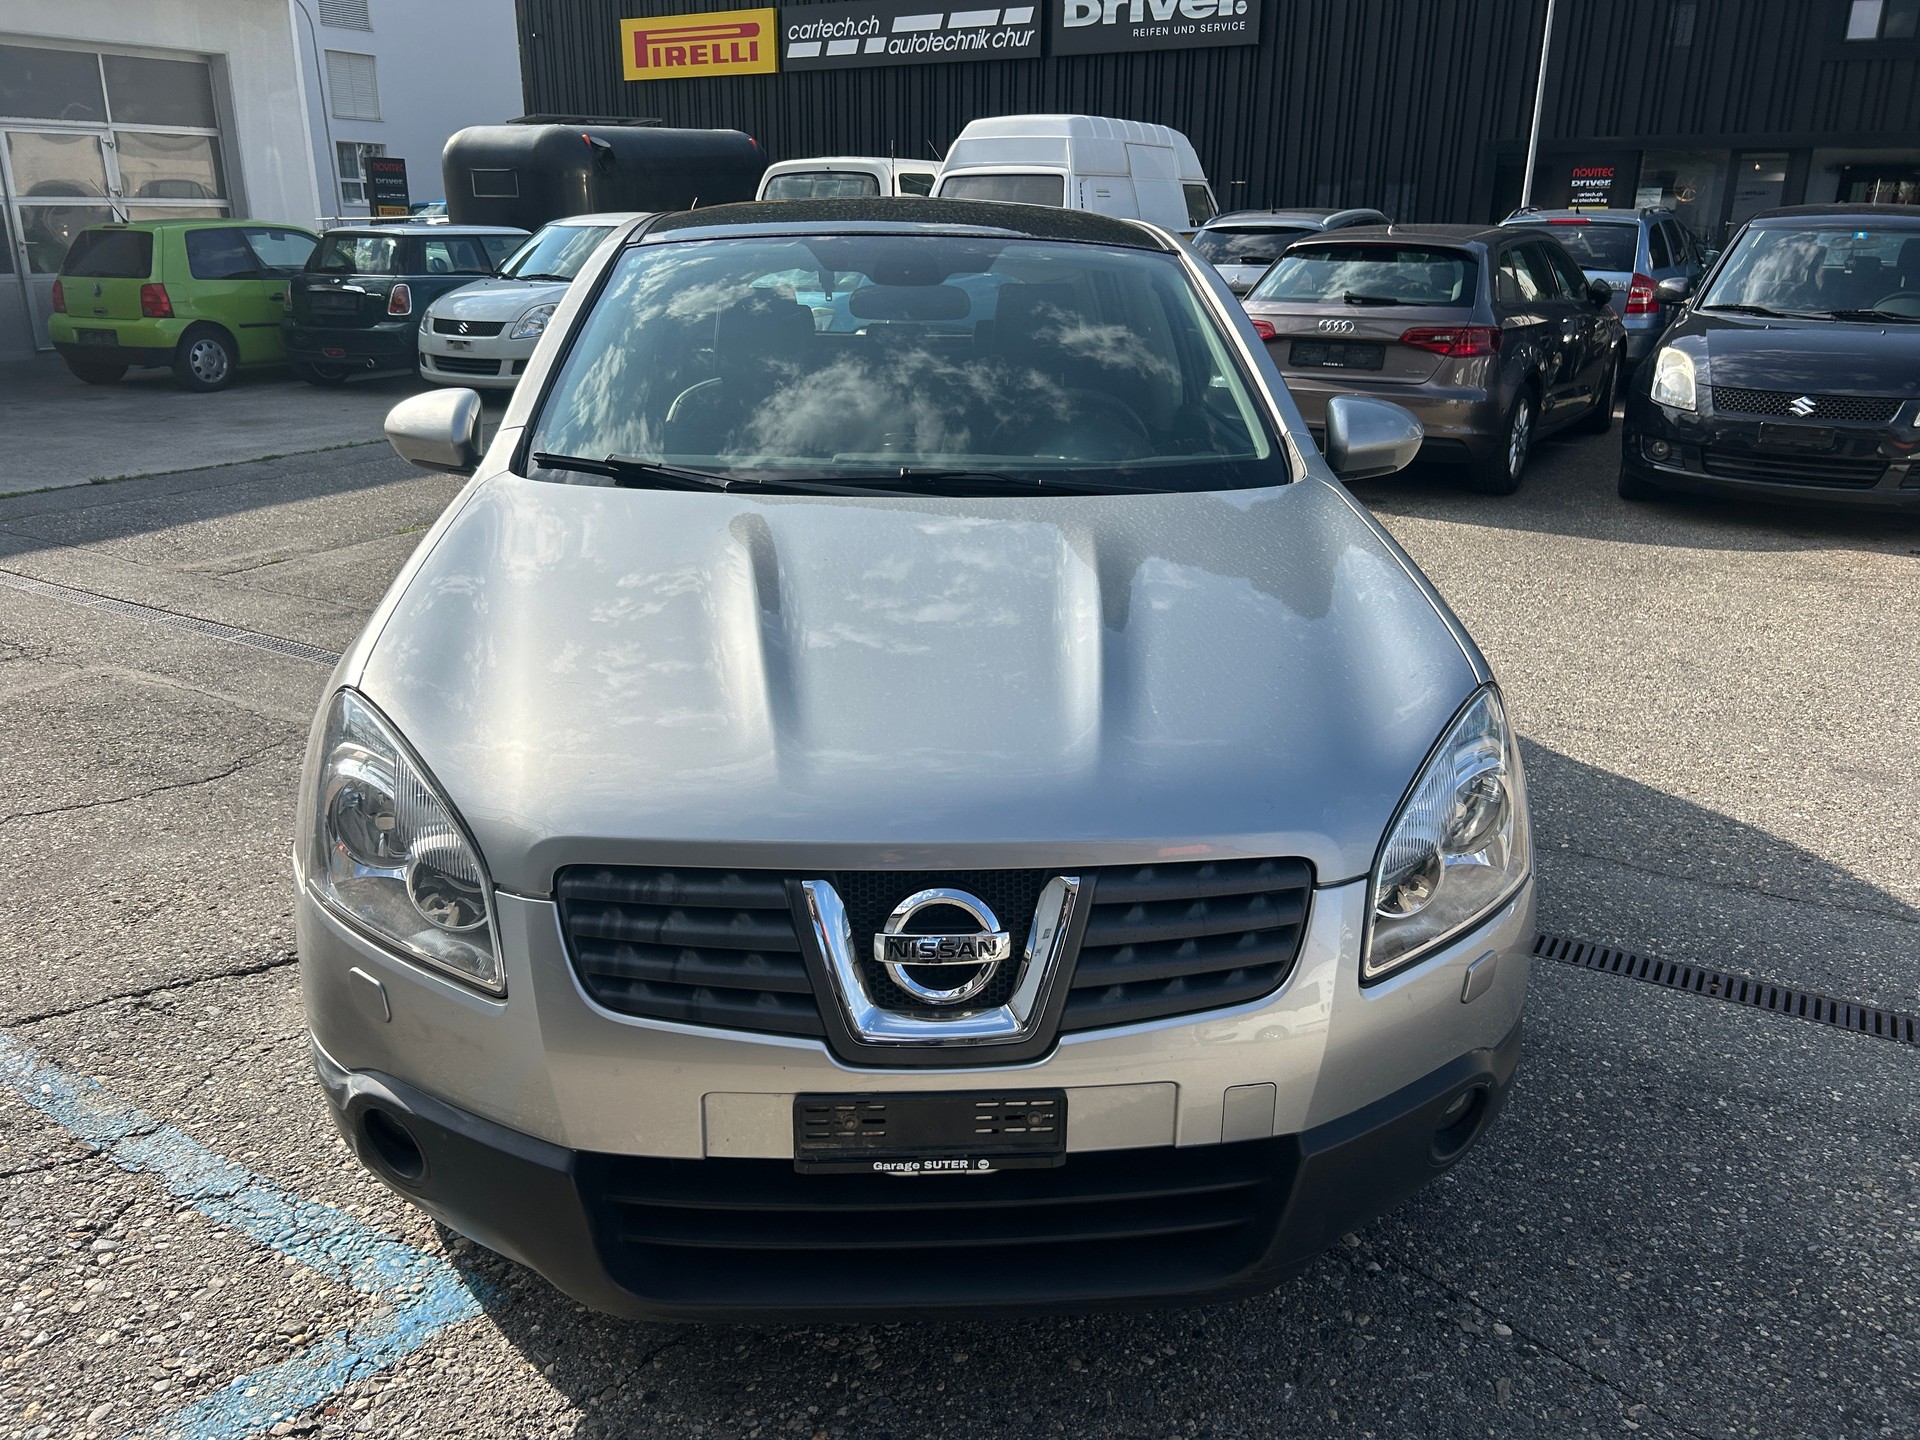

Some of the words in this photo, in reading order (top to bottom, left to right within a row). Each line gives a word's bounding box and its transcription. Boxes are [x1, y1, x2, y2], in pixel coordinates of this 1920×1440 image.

[788, 15, 880, 40] cartech.ch
[1132, 27, 1170, 37] REIFEN
[1173, 25, 1196, 35] UND
[1200, 21, 1246, 33] SERVICE
[634, 22, 760, 68] PIRELLI
[888, 28, 991, 54] autotechnik
[991, 27, 1035, 48] chur
[888, 940, 998, 960] NISSAN
[873, 1161, 920, 1172] Garage
[924, 1160, 969, 1170] SUTER
